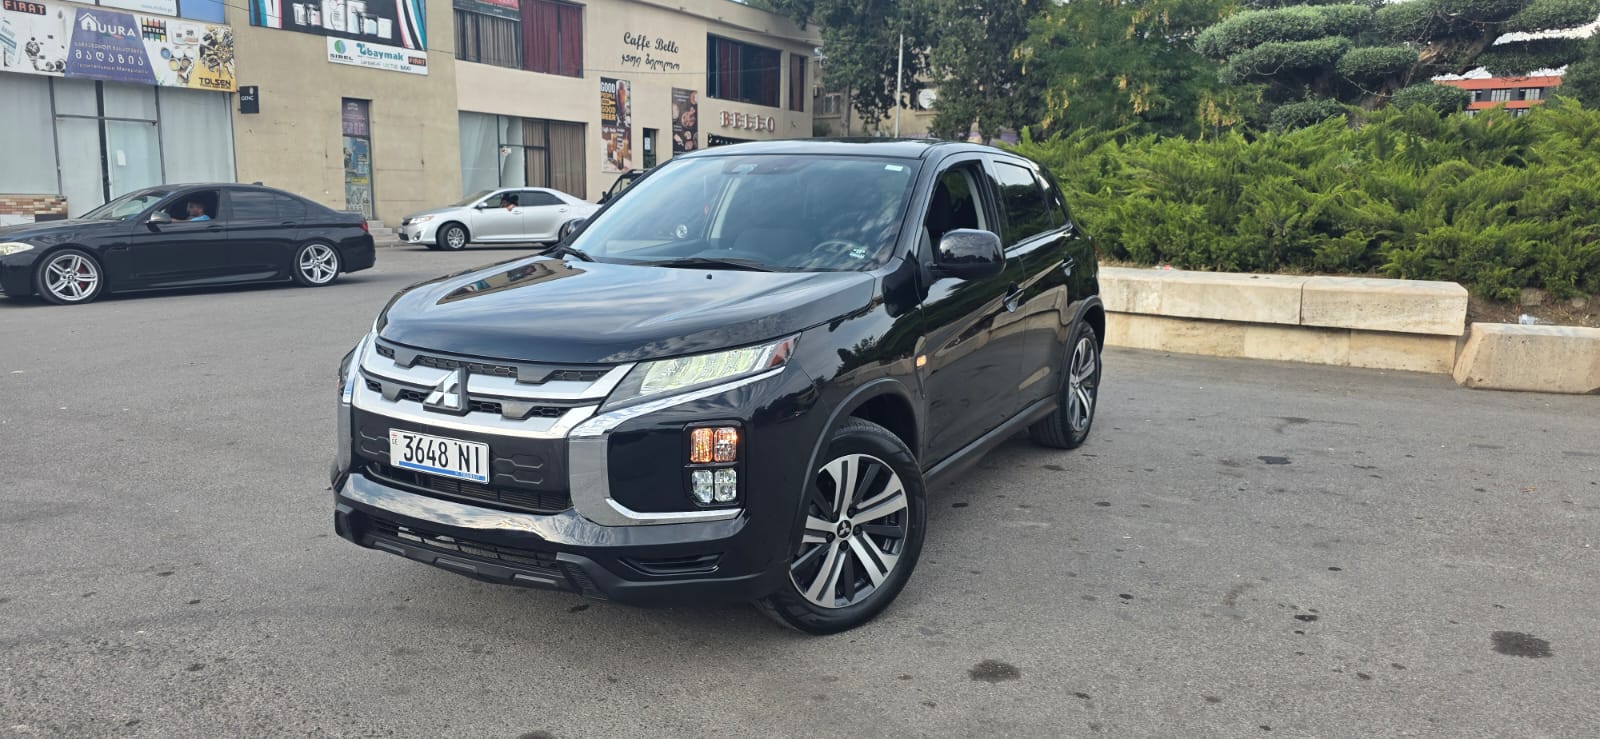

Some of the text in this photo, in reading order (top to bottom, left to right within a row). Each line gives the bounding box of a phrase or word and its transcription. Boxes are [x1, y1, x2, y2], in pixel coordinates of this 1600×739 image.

[4, 0, 45, 15] FIRAT
[623, 31, 679, 54] Caffe Bello
[75, 49, 145, 66] მაღაზია
[199, 77, 231, 86] TOLSEN
[600, 82, 615, 93] GOOD
[720, 110, 776, 133] BELLO
[402, 434, 480, 474] 3648 NI
